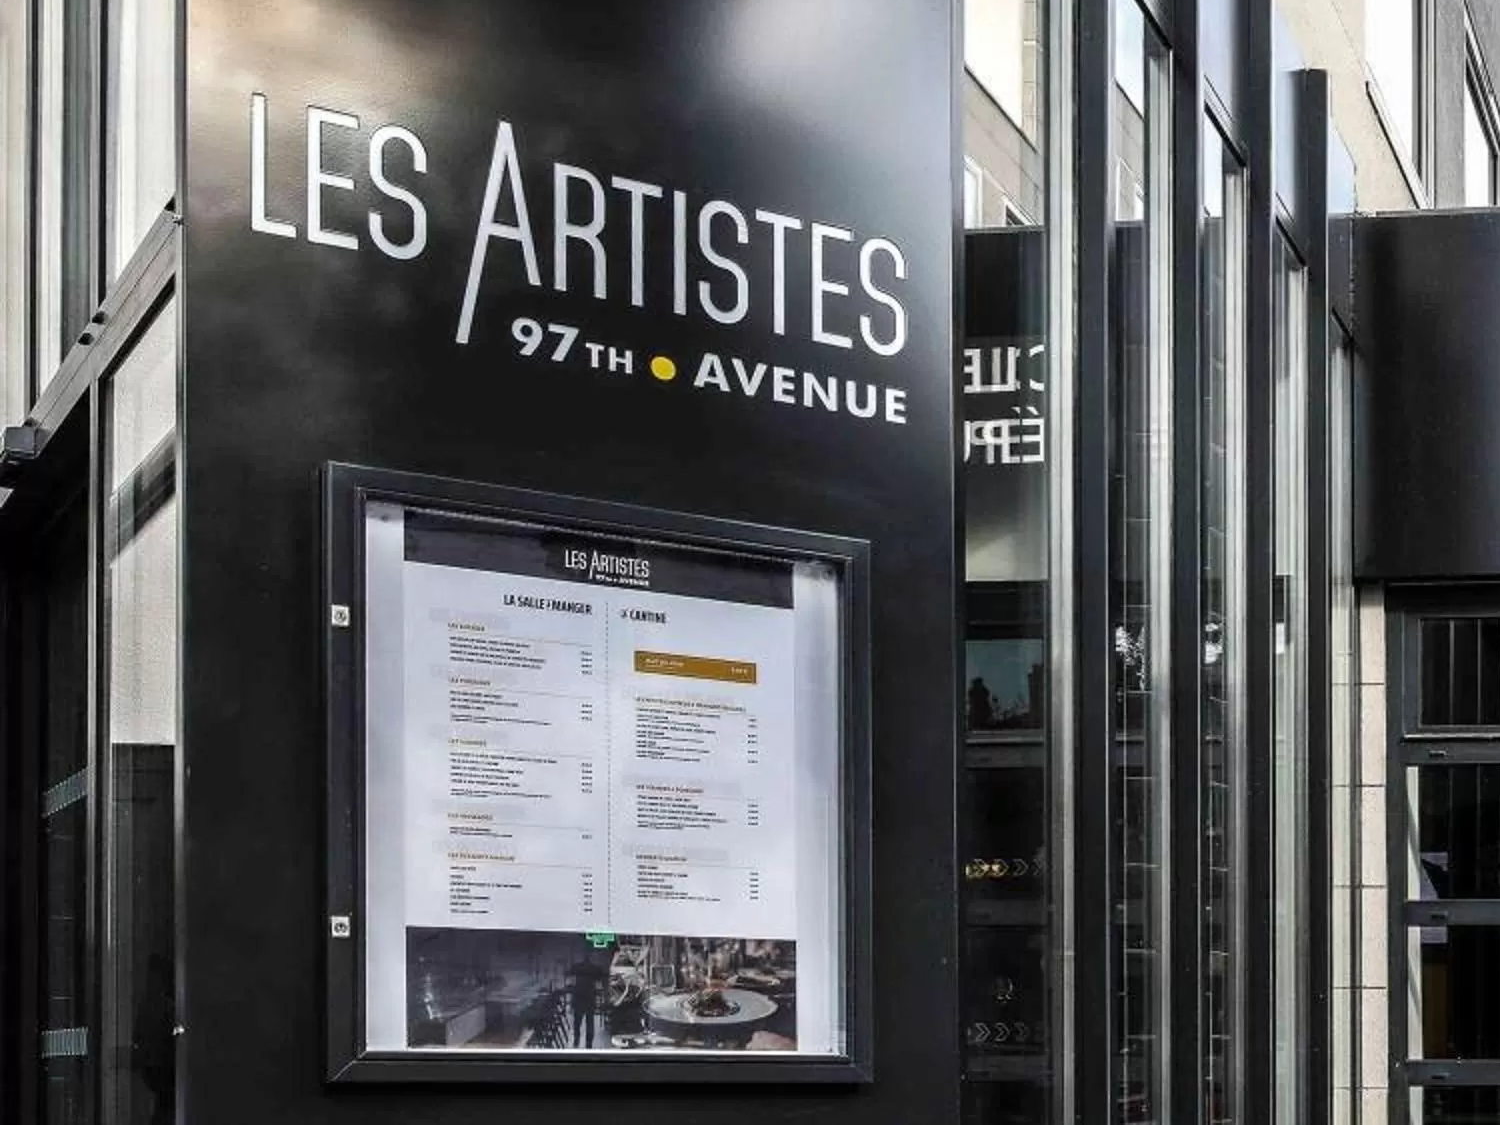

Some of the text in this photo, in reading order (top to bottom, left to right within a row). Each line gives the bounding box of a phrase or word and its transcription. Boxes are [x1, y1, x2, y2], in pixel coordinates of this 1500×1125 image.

[251, 93, 908, 356] LES ARTISTES
[511, 316, 908, 424] 97TH AVENUE
[565, 549, 650, 580] LES ARTISTES
